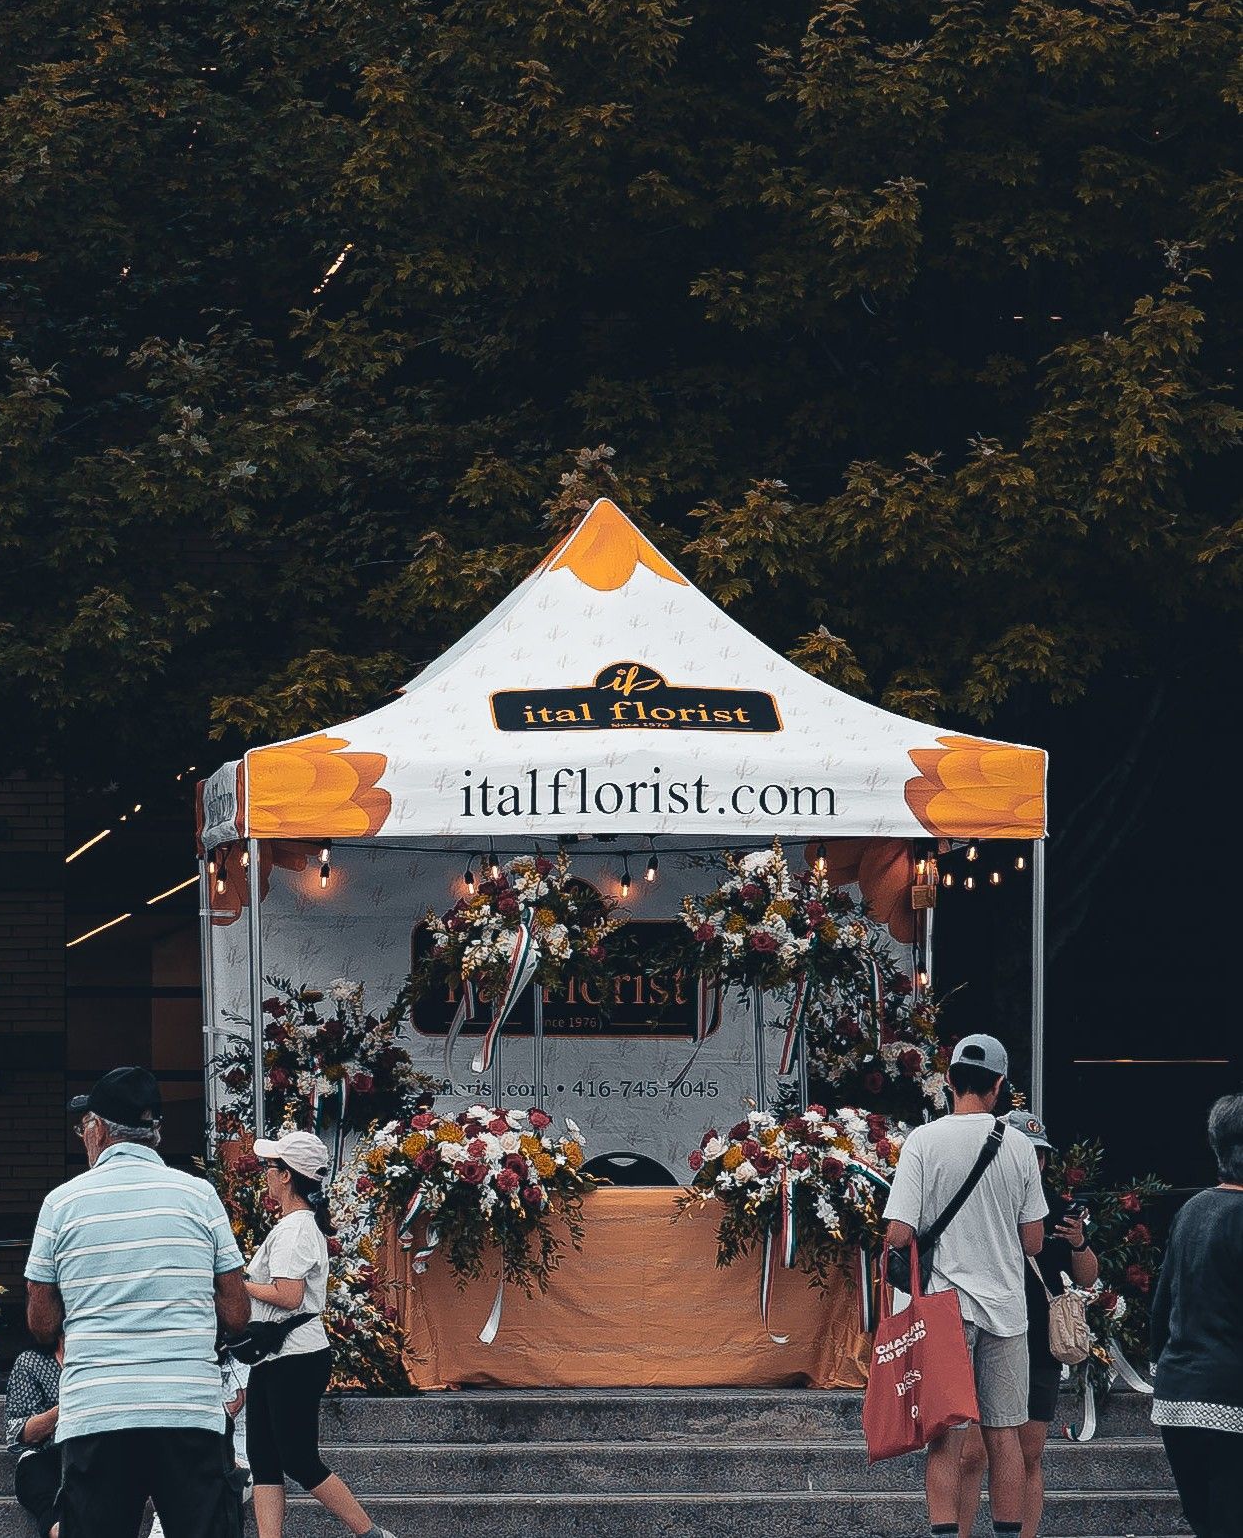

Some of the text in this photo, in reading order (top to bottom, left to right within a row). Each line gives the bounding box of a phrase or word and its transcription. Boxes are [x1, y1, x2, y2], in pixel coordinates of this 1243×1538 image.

[523, 701, 751, 724] ital florist
[460, 766, 837, 817] italflorist.com
[571, 1078, 719, 1099] 416-745-7045
